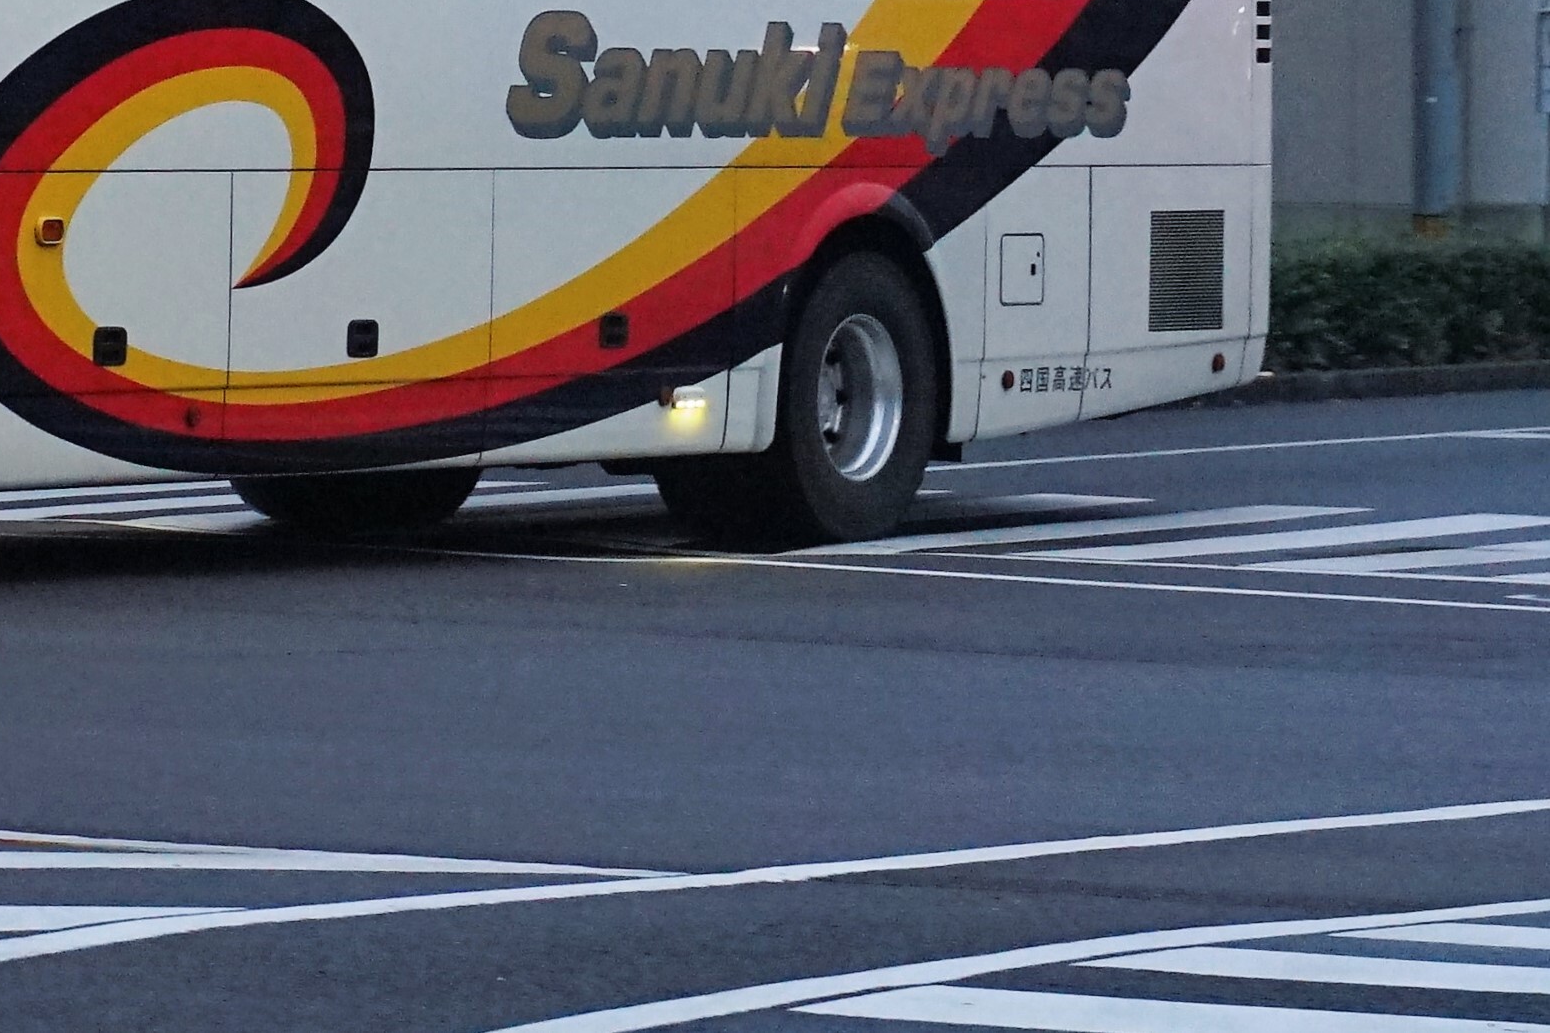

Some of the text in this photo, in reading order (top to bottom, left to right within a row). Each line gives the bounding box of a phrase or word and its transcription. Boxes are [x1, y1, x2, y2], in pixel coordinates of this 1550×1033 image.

[506, 9, 1131, 157] Sanuki Express
[1020, 366, 1112, 393] 四国高速バス
